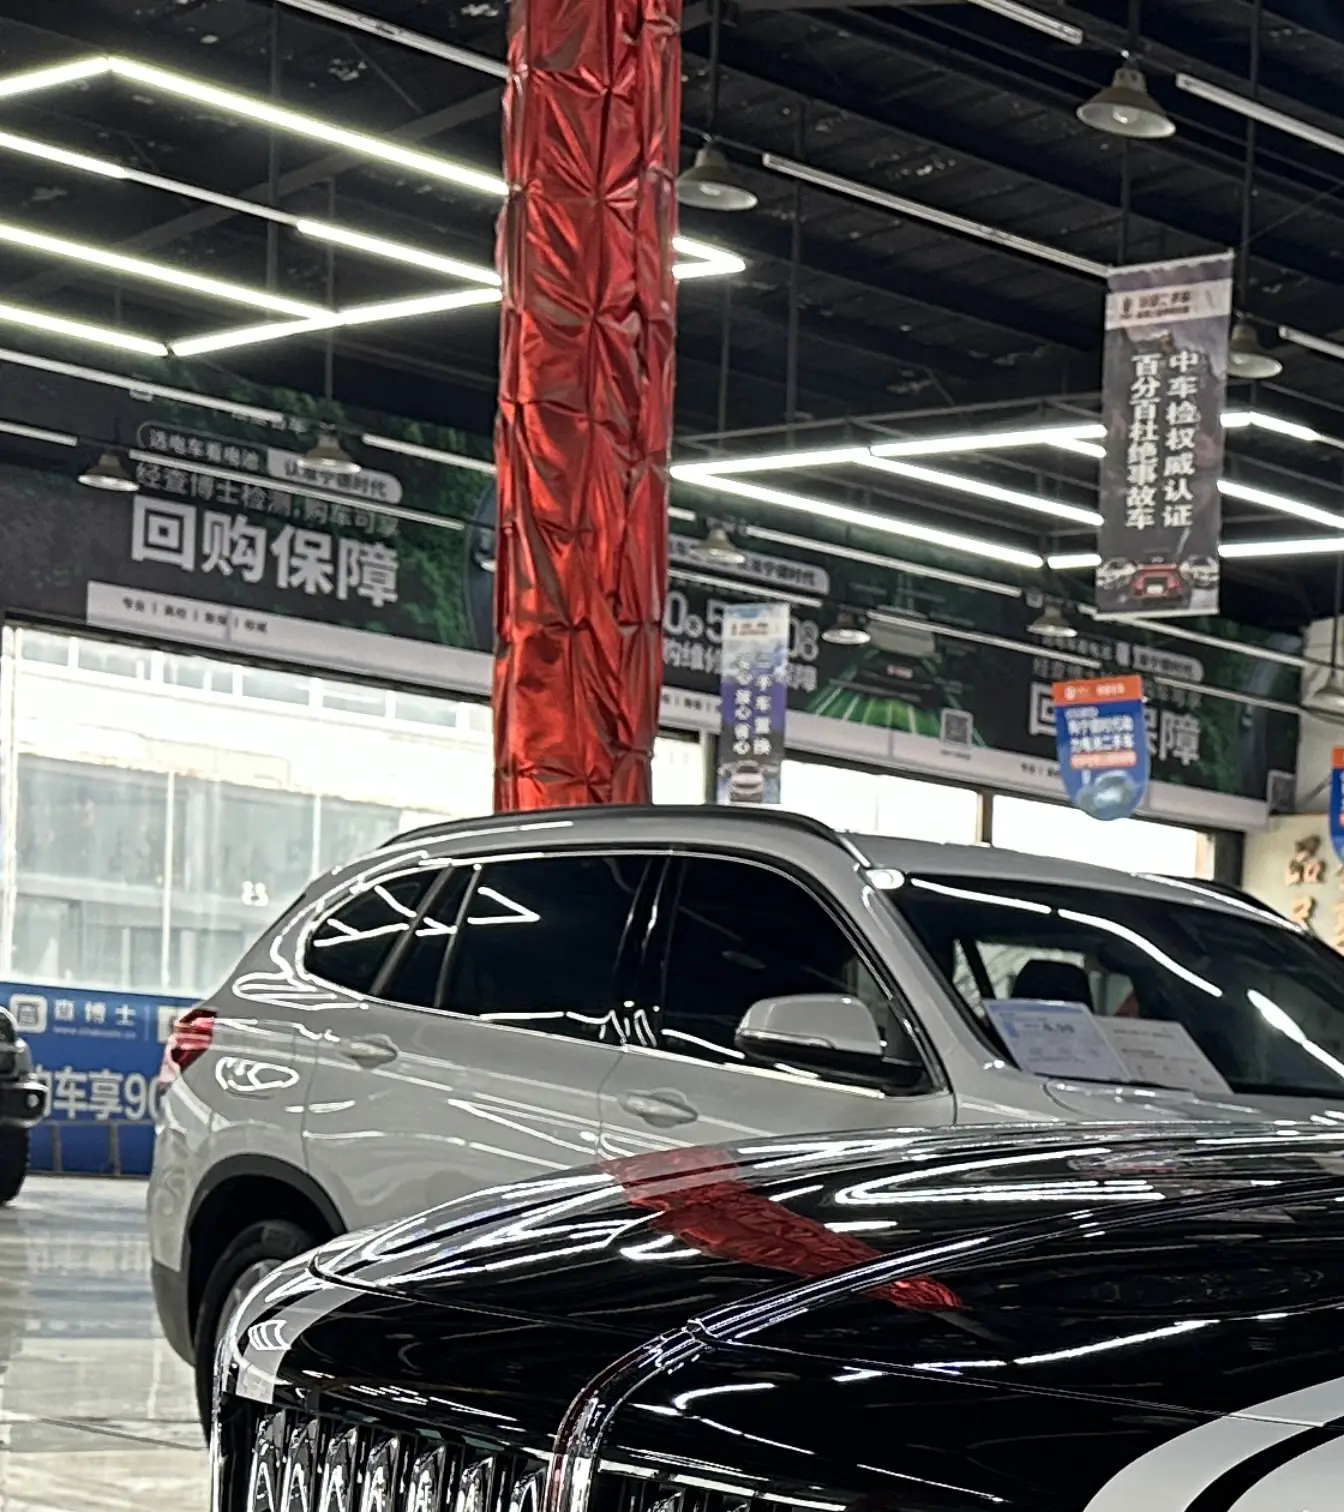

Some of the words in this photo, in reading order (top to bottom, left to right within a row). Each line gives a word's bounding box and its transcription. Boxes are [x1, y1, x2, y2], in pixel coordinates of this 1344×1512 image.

[1162, 350, 1201, 529] 中车检权威认证
[131, 494, 400, 608] 回购保障
